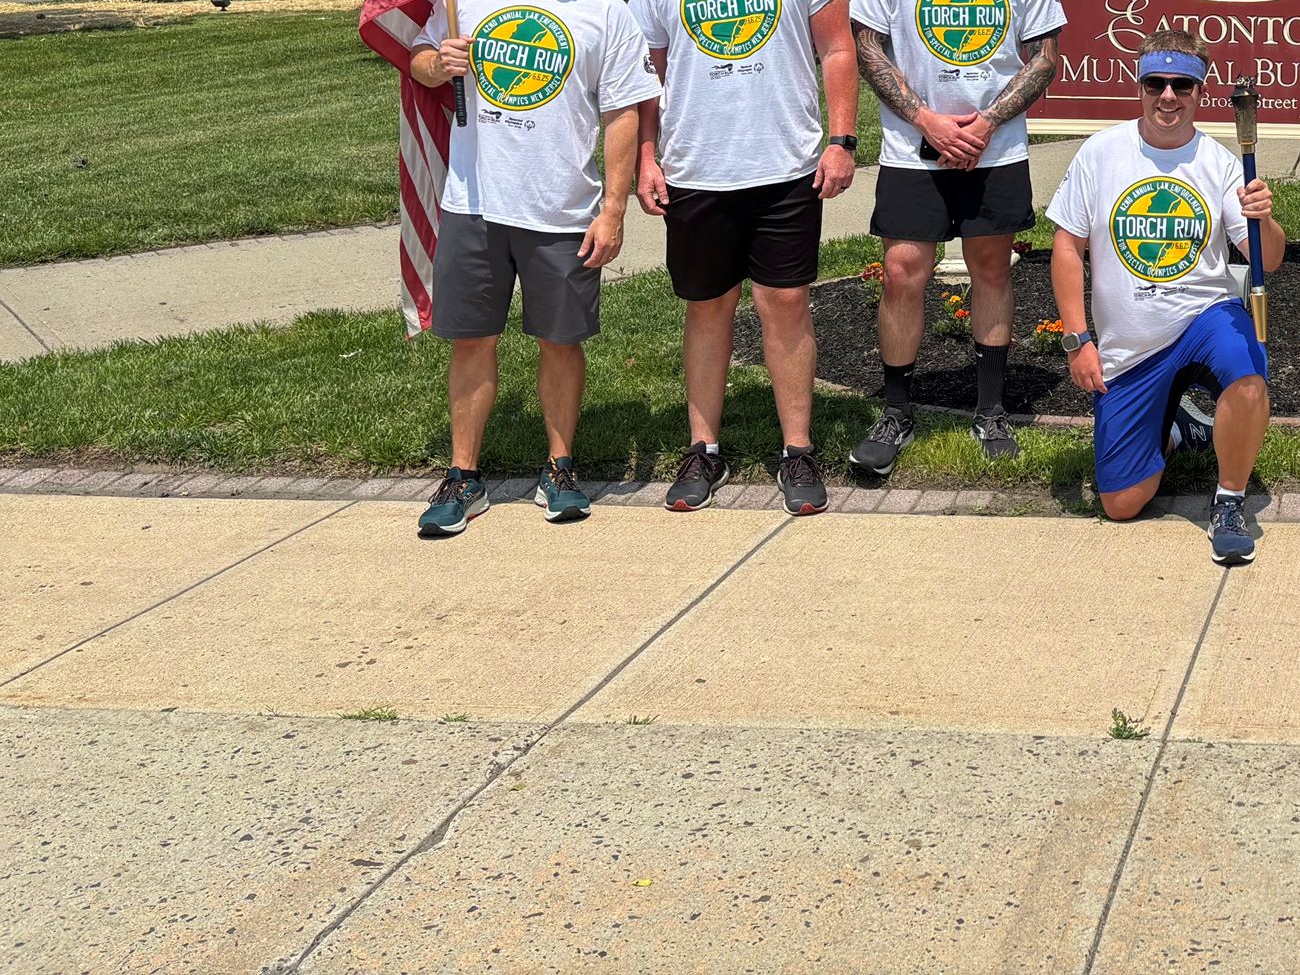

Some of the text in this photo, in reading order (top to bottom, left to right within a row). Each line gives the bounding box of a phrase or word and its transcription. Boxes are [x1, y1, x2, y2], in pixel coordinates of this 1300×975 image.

[922, 6, 1004, 25] TORCH RUN
[482, 11, 568, 50] 42ND ANNUAL LAW ENFORCEMENT
[476, 38, 567, 74] TORCH RUN
[929, 38, 950, 57] SPECIAL
[1059, 54, 1238, 85] MUNAL
[531, 92, 544, 103] NEW
[545, 75, 561, 97] JERSEY
[1200, 92, 1233, 108] Broa
[1133, 183, 1154, 198] ANNUAL
[1156, 182, 1168, 190] LAW
[1171, 183, 1203, 215] ENFORCEMENT
[1116, 216, 1204, 239] TORCH RUN
[1123, 251, 1144, 273] SPECIAL
